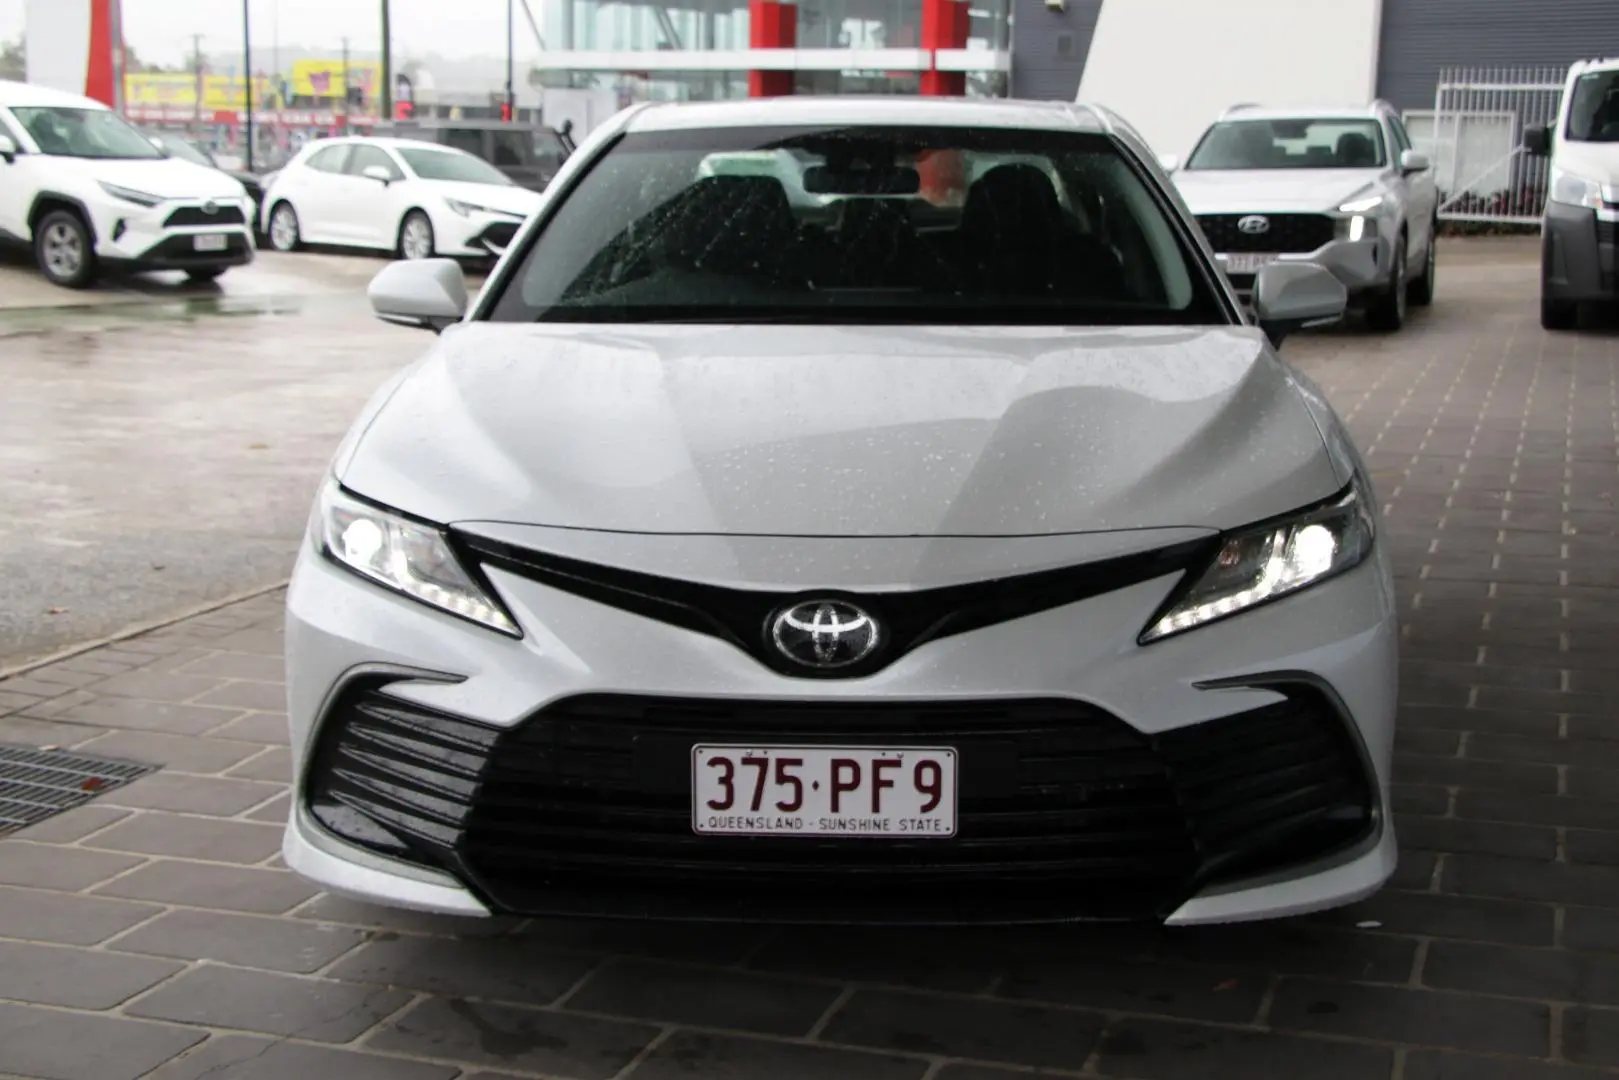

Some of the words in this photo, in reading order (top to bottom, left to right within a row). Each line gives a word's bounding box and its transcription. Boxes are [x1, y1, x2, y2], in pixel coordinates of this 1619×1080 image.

[708, 816, 804, 830] QUEENSLAND
[819, 818, 891, 831] SUNSHINE
[898, 818, 941, 832] STATE
